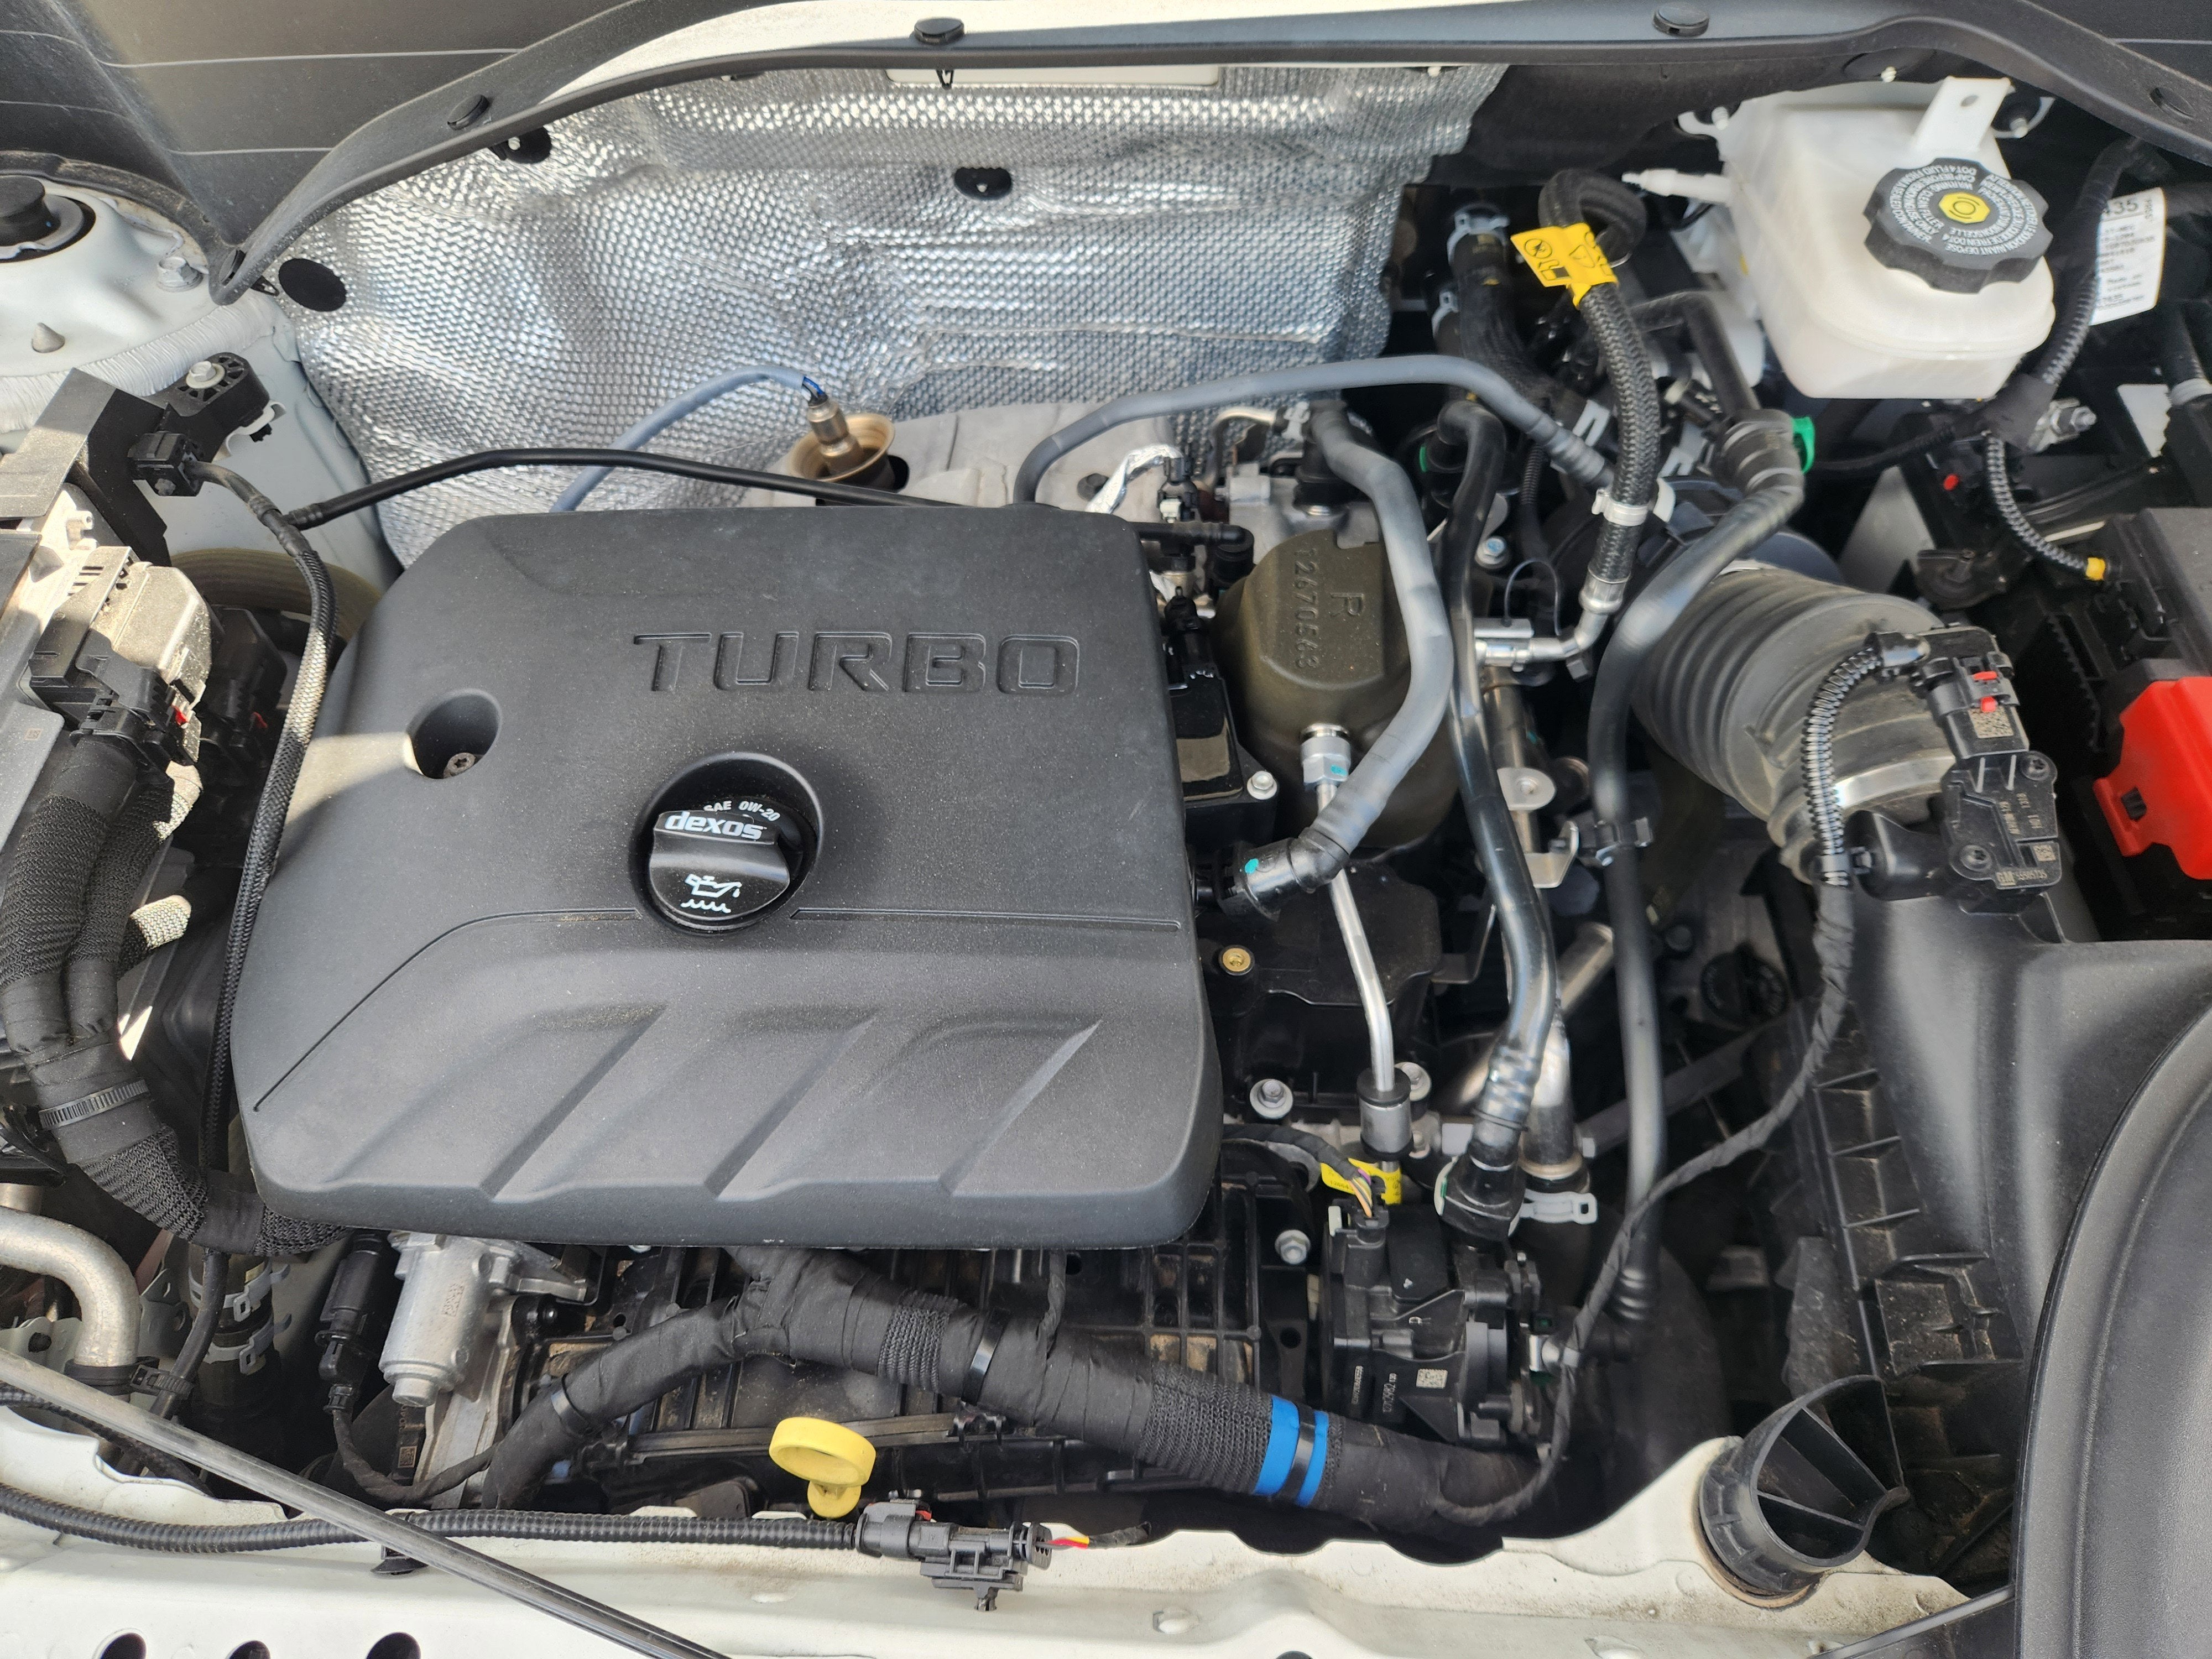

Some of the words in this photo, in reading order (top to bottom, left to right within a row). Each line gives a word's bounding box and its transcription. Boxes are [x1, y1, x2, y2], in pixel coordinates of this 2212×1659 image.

[1898, 169, 1926, 185] FROM
[1920, 164, 1950, 175] FLUID
[1954, 173, 1976, 183] CAP
[1889, 185, 1905, 209] SEALED
[1912, 219, 1939, 237] ONLY
[1918, 208, 1945, 230] FILLER
[1966, 238, 1993, 246] FREIN
[1978, 244, 2010, 255] AVANT
[1330, 591, 1365, 618] R
[633, 632, 1081, 693] TURBO
[738, 801, 781, 822] 0W-20
[665, 811, 763, 839] dexos
